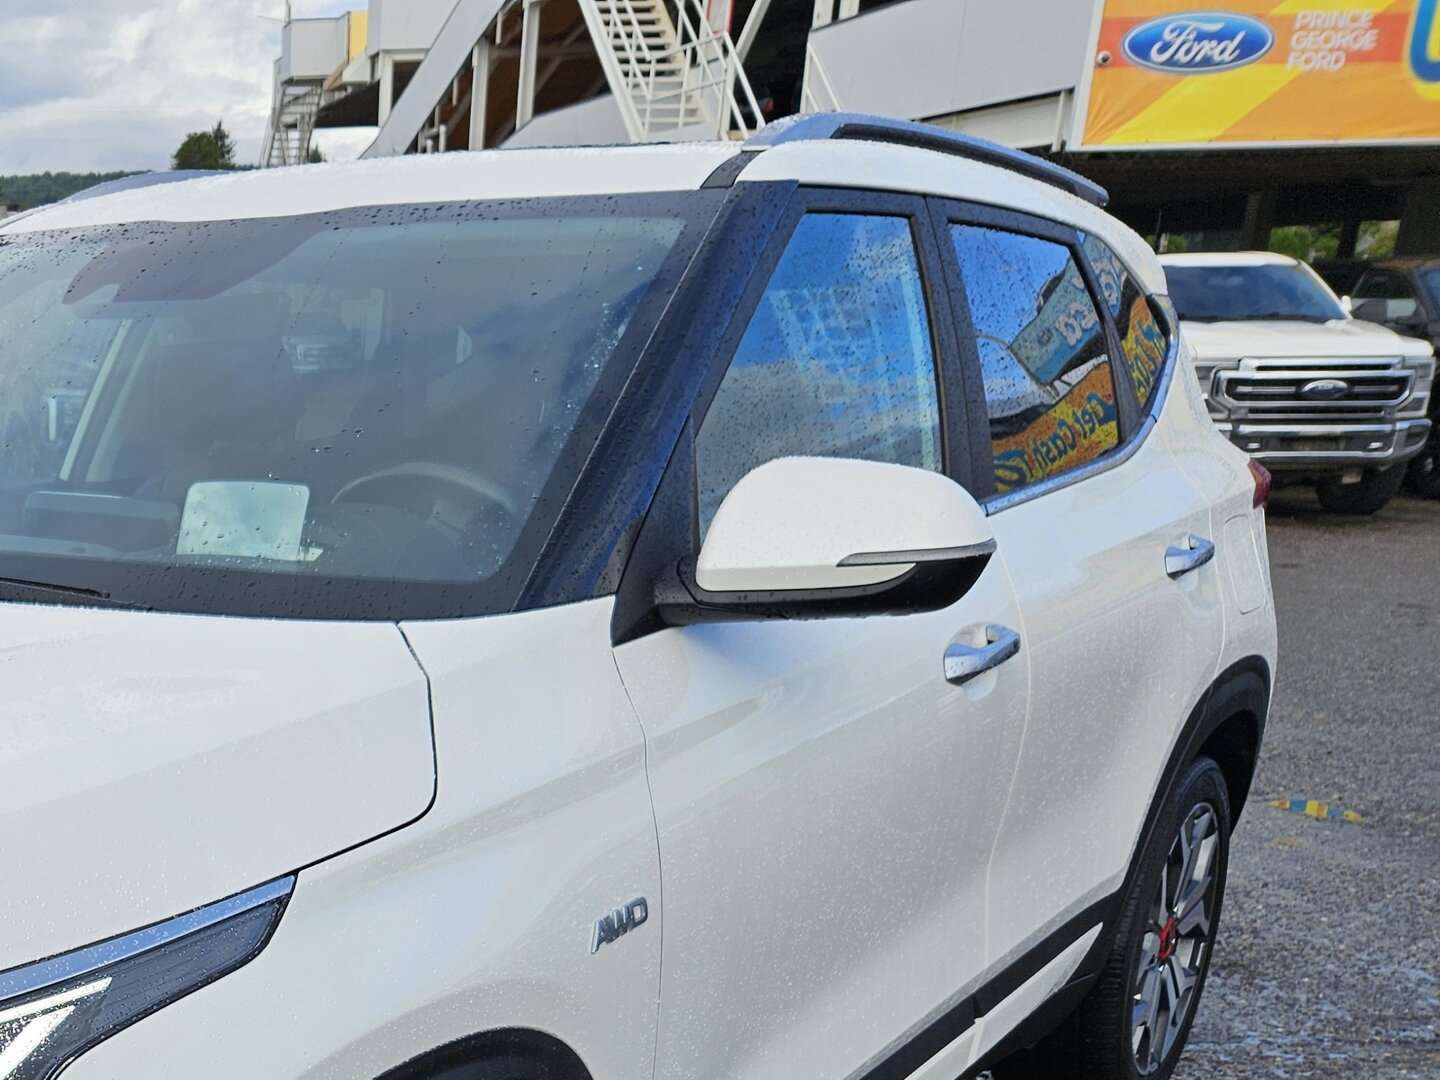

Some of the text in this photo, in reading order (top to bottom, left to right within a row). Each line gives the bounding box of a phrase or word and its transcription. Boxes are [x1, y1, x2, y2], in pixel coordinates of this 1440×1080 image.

[1295, 9, 1374, 29] PRINCE
[1150, 20, 1248, 64] Ford
[1290, 29, 1379, 51] GEORGE
[1285, 51, 1346, 71] FORD
[590, 896, 649, 955] AWD
